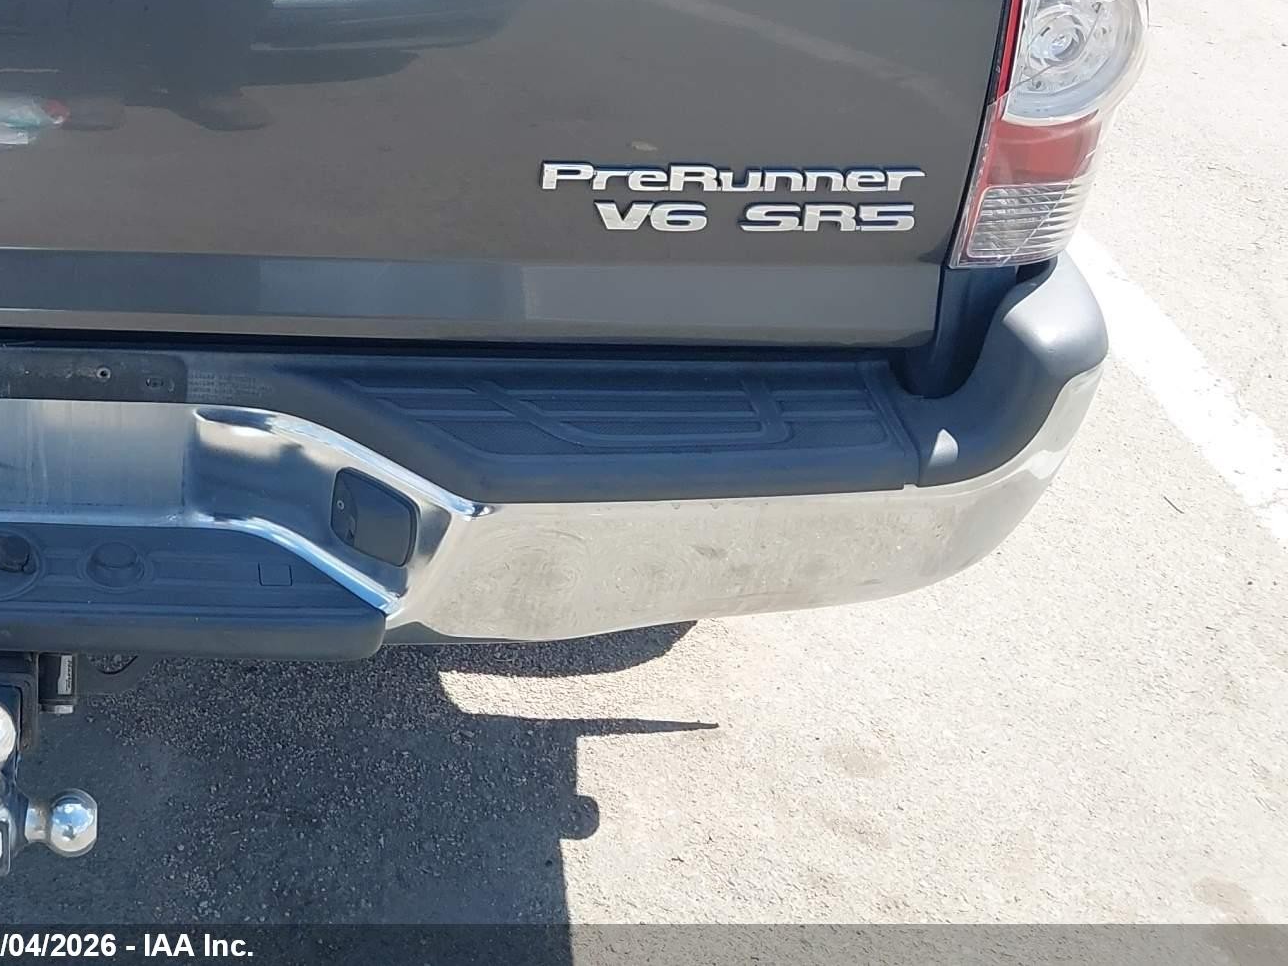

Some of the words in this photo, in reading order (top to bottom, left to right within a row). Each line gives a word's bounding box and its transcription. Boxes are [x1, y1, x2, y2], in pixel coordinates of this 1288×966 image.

[541, 161, 926, 192] PreRunner
[594, 201, 708, 232] V6
[740, 201, 915, 232] SR5
